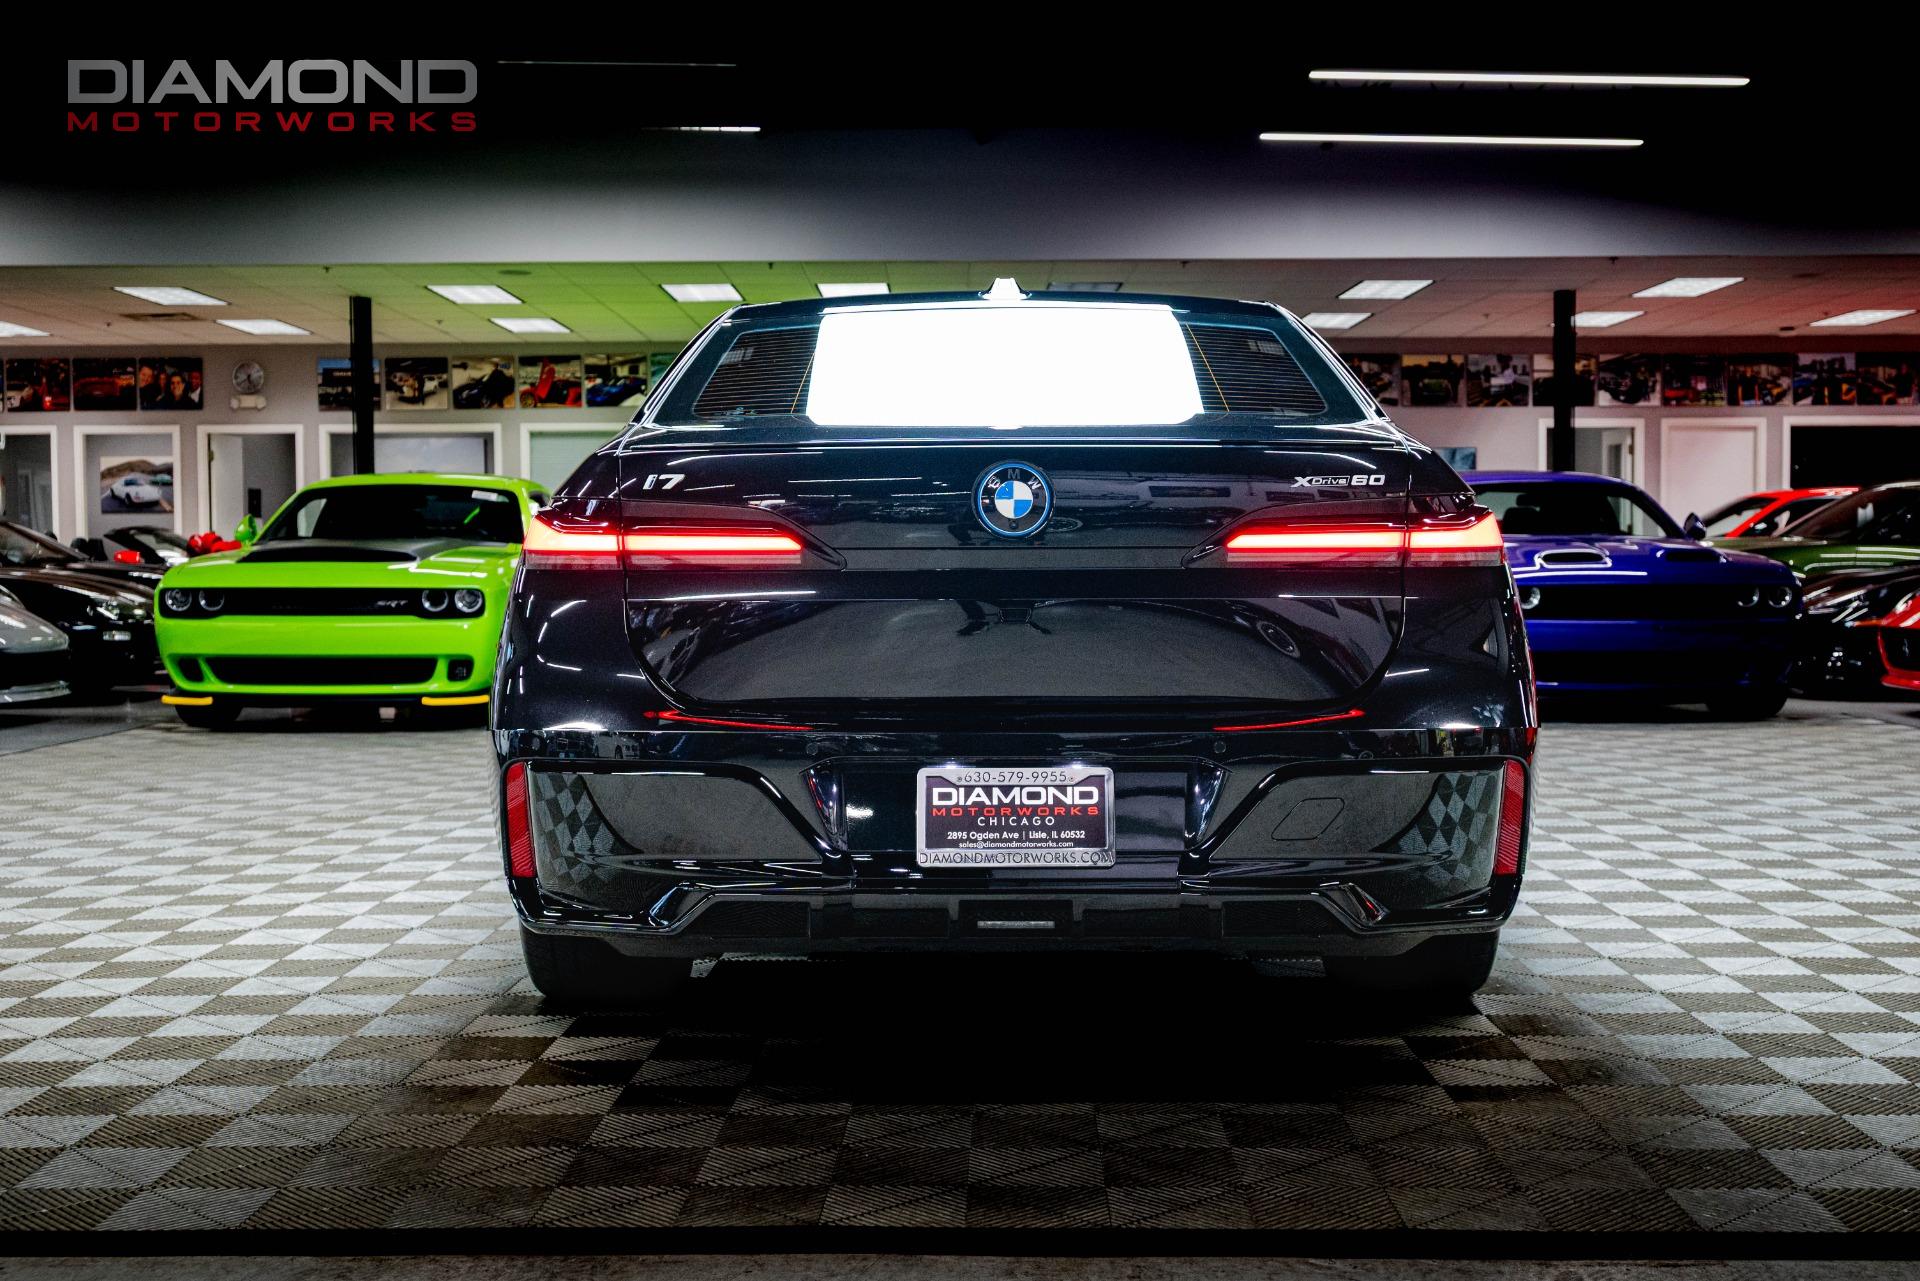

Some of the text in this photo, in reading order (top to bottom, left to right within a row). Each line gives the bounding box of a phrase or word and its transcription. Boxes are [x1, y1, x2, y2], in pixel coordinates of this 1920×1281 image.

[964, 771, 1067, 783] 630-579-9955
[932, 786, 1099, 806] DIAMOND
[932, 806, 1099, 817] MOTORWORKS
[977, 816, 1055, 826] CHICAGO
[947, 831, 967, 840] 2895
[969, 831, 1000, 841] Ogden
[1001, 831, 1019, 839] Ave
[1029, 830, 1050, 840] Lisle,
[1051, 831, 1059, 839] IL
[1060, 831, 1086, 839] 60532
[959, 840, 1074, 849] sales@diamondmotorworks.com
[919, 852, 1114, 865] DIAMONDMOTORWORKS.COM
